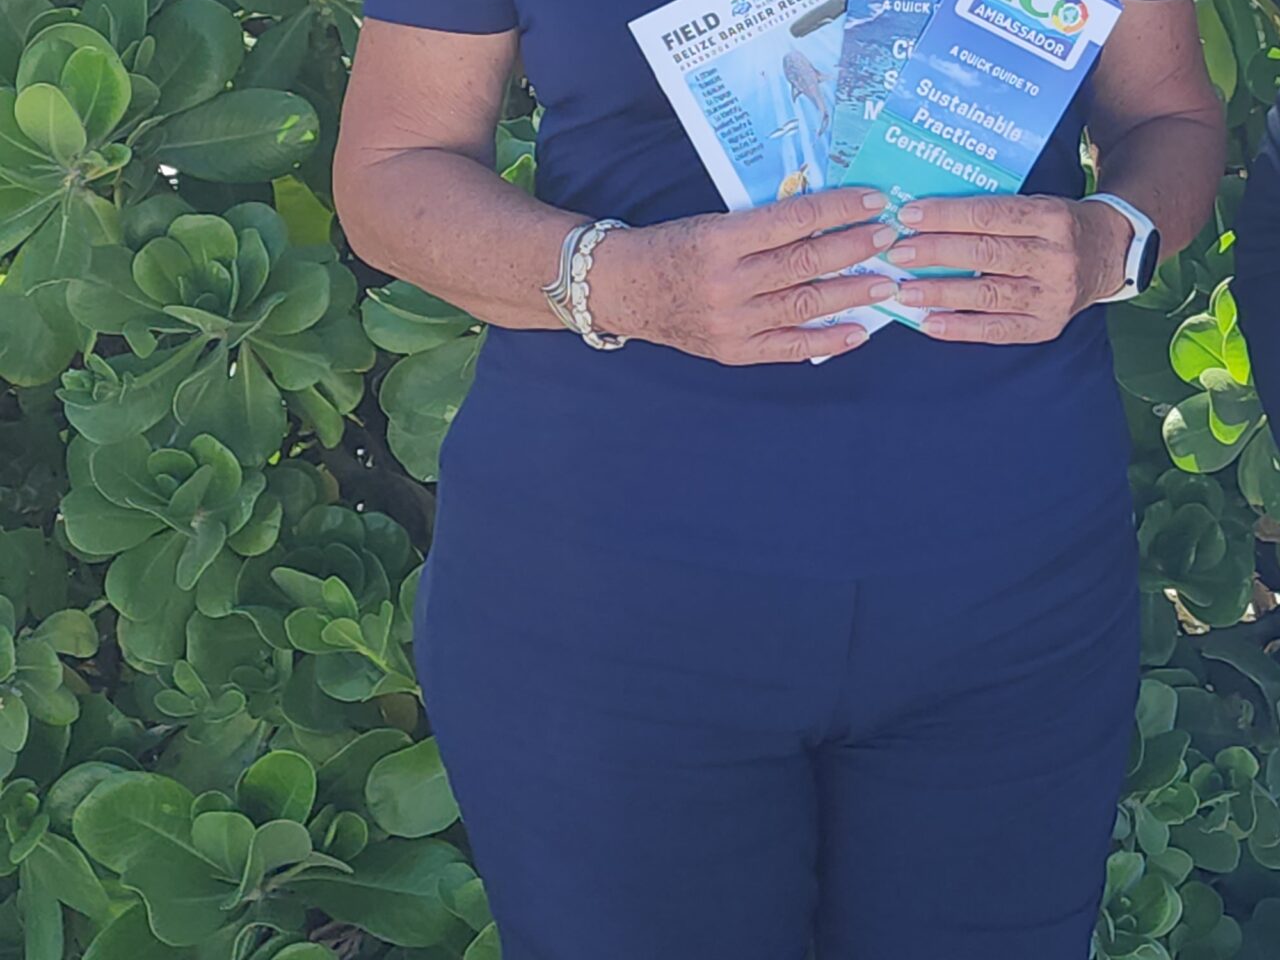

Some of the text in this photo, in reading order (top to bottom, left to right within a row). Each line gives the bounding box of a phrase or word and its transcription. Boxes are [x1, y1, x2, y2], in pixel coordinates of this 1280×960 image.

[661, 11, 721, 52] FIELD
[883, 0, 892, 11] A
[894, 0, 931, 14] QUICK
[974, 3, 1065, 57] AMBASSADOR
[672, 35, 717, 64] BELIZE
[719, 7, 776, 41] BARRIER
[949, 45, 1040, 97] A QUICK GUIDE TO
[912, 106, 998, 161] Practices
[916, 78, 1023, 141] Sustainable
[885, 125, 998, 192] Certification
